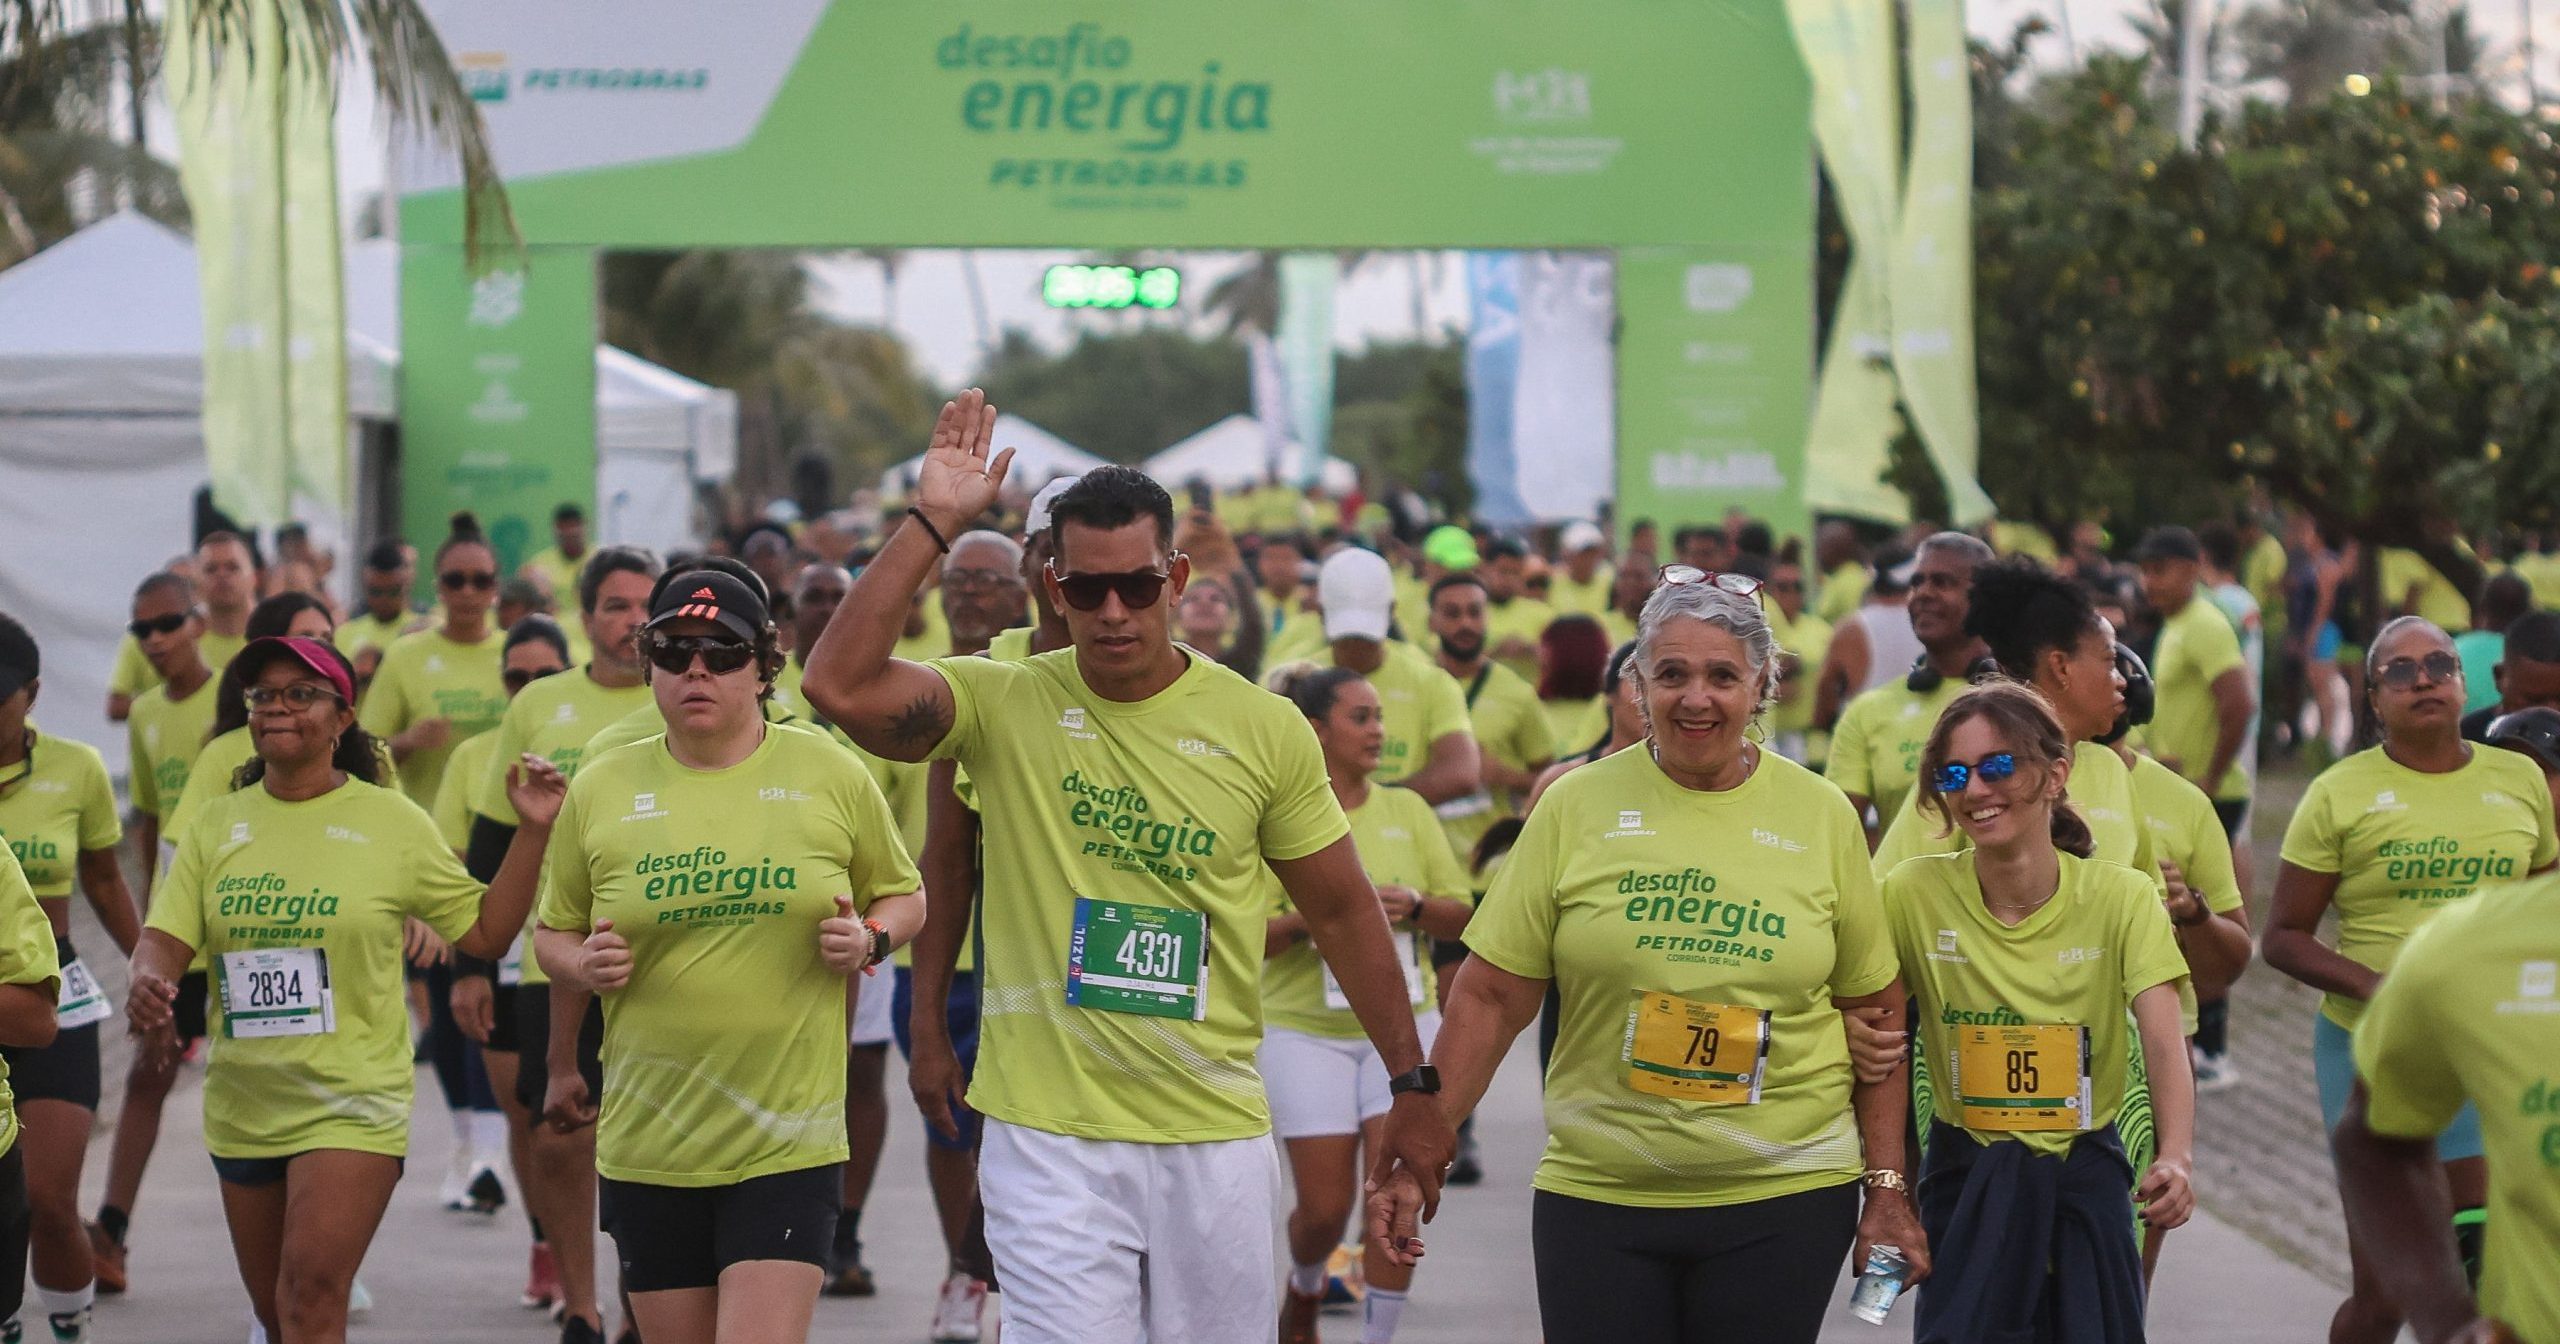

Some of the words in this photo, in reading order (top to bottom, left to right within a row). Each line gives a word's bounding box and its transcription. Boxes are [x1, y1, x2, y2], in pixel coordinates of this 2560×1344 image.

[936, 22, 1133, 80] desafio
[524, 67, 709, 90] PETROBRAS
[962, 60, 1272, 152] energia
[989, 158, 1248, 188] PETROBRAS
[636, 846, 727, 876] desafio
[1082, 840, 1198, 882] PETRBRAS
[2378, 836, 2459, 858] desafio
[216, 872, 286, 895] desafio
[645, 857, 797, 901] energia
[1618, 868, 1717, 897] desafio
[2387, 849, 2514, 885] energia
[220, 888, 340, 925] energia
[658, 901, 786, 924] PETROBRAS
[1625, 895, 1787, 940] energia
[229, 927, 325, 940] PETROBRAS
[1071, 927, 1086, 965] AZUL
[1635, 935, 1775, 962] PETROBRAS
[1115, 929, 1183, 979] 4331
[1666, 953, 1707, 964] CORRIDA
[248, 969, 303, 1008] 2834
[1621, 1010, 1638, 1062] PETROBRAS
[1684, 1025, 1720, 1067] 79
[2006, 1050, 2039, 1093] 85
